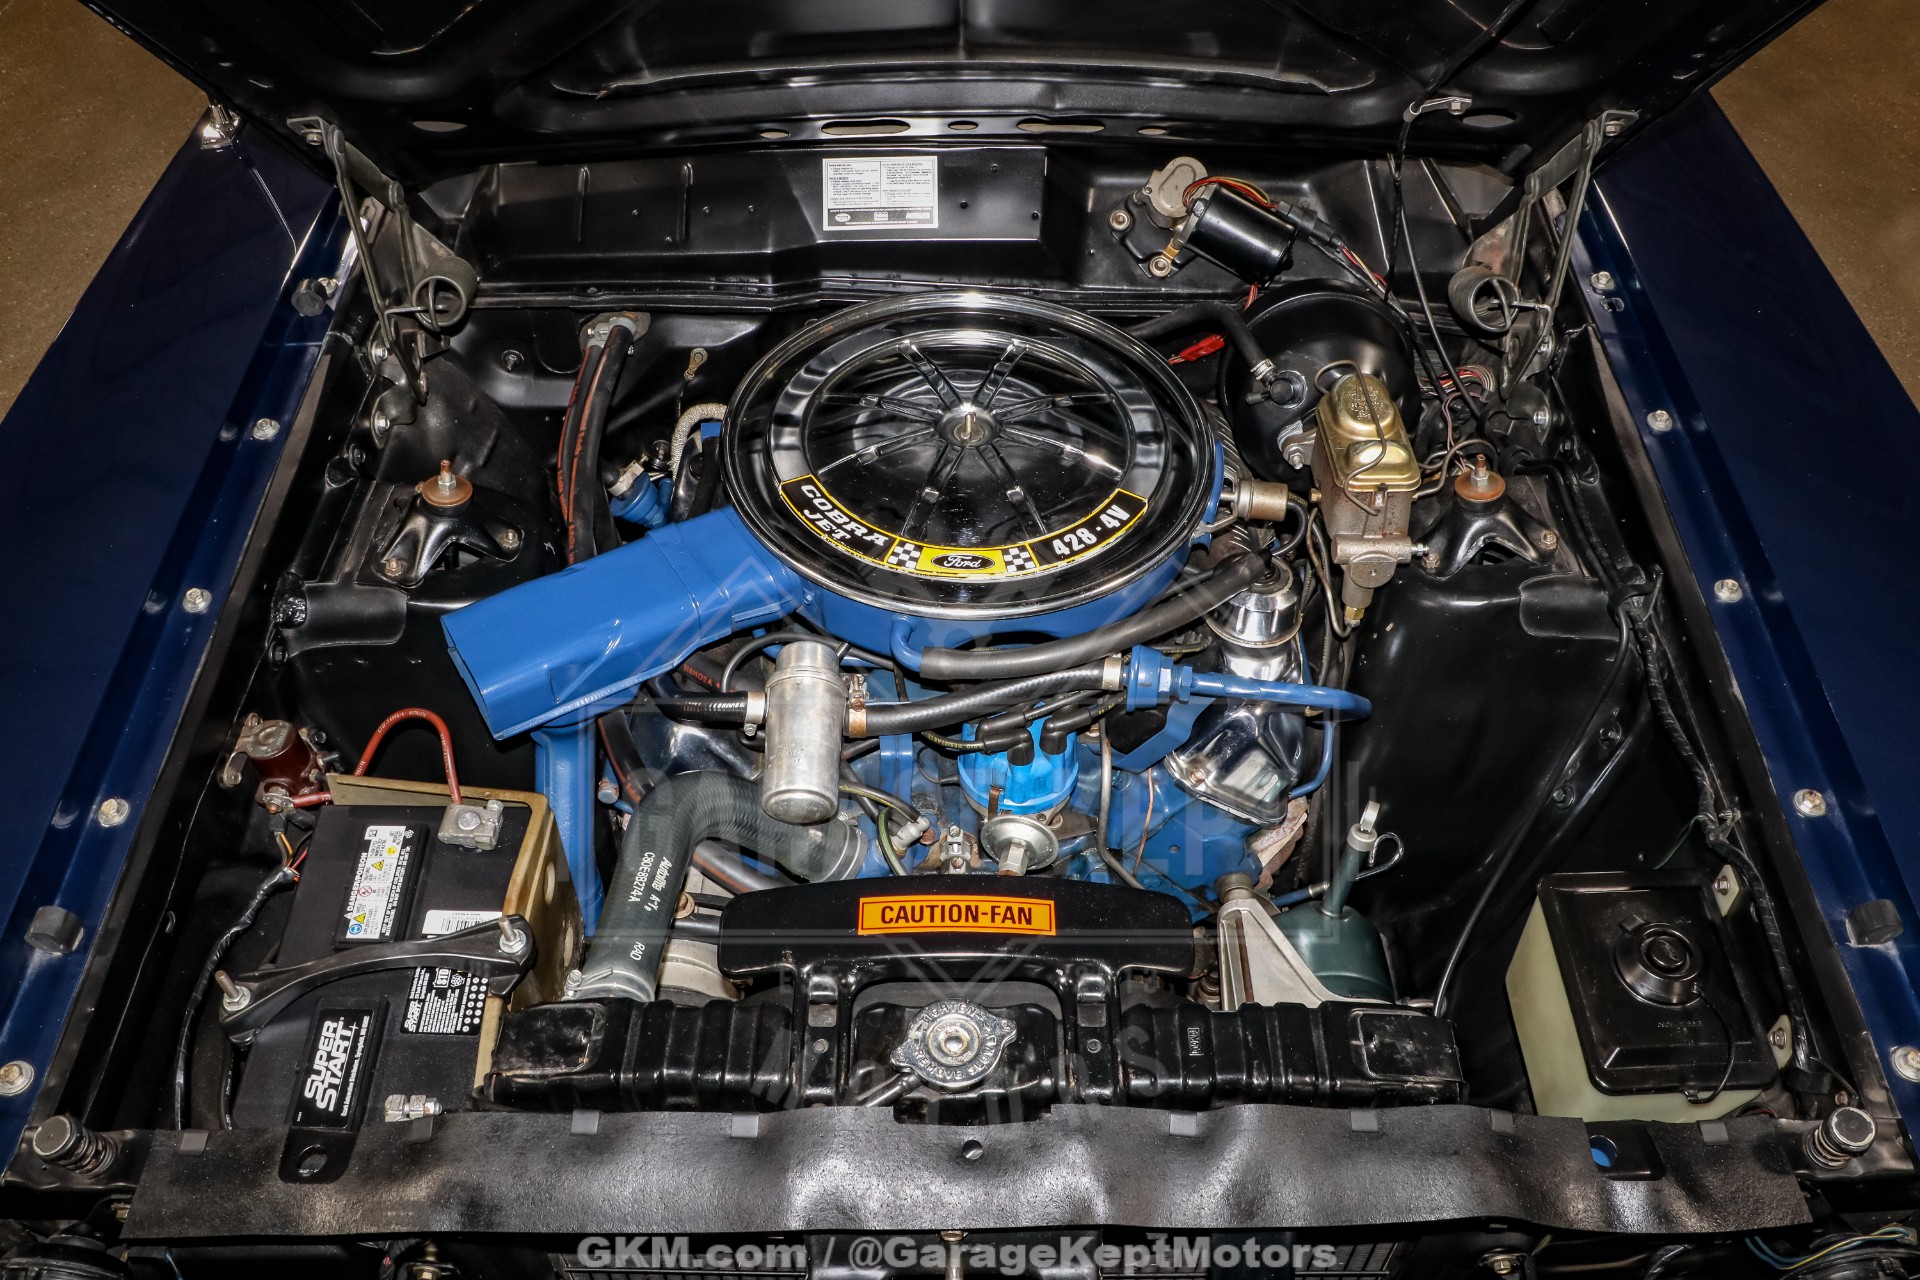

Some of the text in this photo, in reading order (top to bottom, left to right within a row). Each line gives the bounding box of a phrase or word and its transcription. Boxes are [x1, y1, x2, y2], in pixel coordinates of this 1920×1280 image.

[800, 485, 889, 547] COBRA
[803, 509, 852, 542] JET
[1052, 504, 1131, 557] 428 4V
[943, 553, 982, 569] Ford
[347, 852, 368, 912] DANGER/POISON
[881, 903, 1033, 926] CAUTION-FAN
[630, 941, 646, 961] RAD
[404, 1000, 418, 1028] SUPER
[922, 1003, 977, 1026] TIGHTEN
[304, 1020, 338, 1100] SUPER
[316, 1019, 353, 1112] START
[914, 1048, 963, 1080] REMOVE
